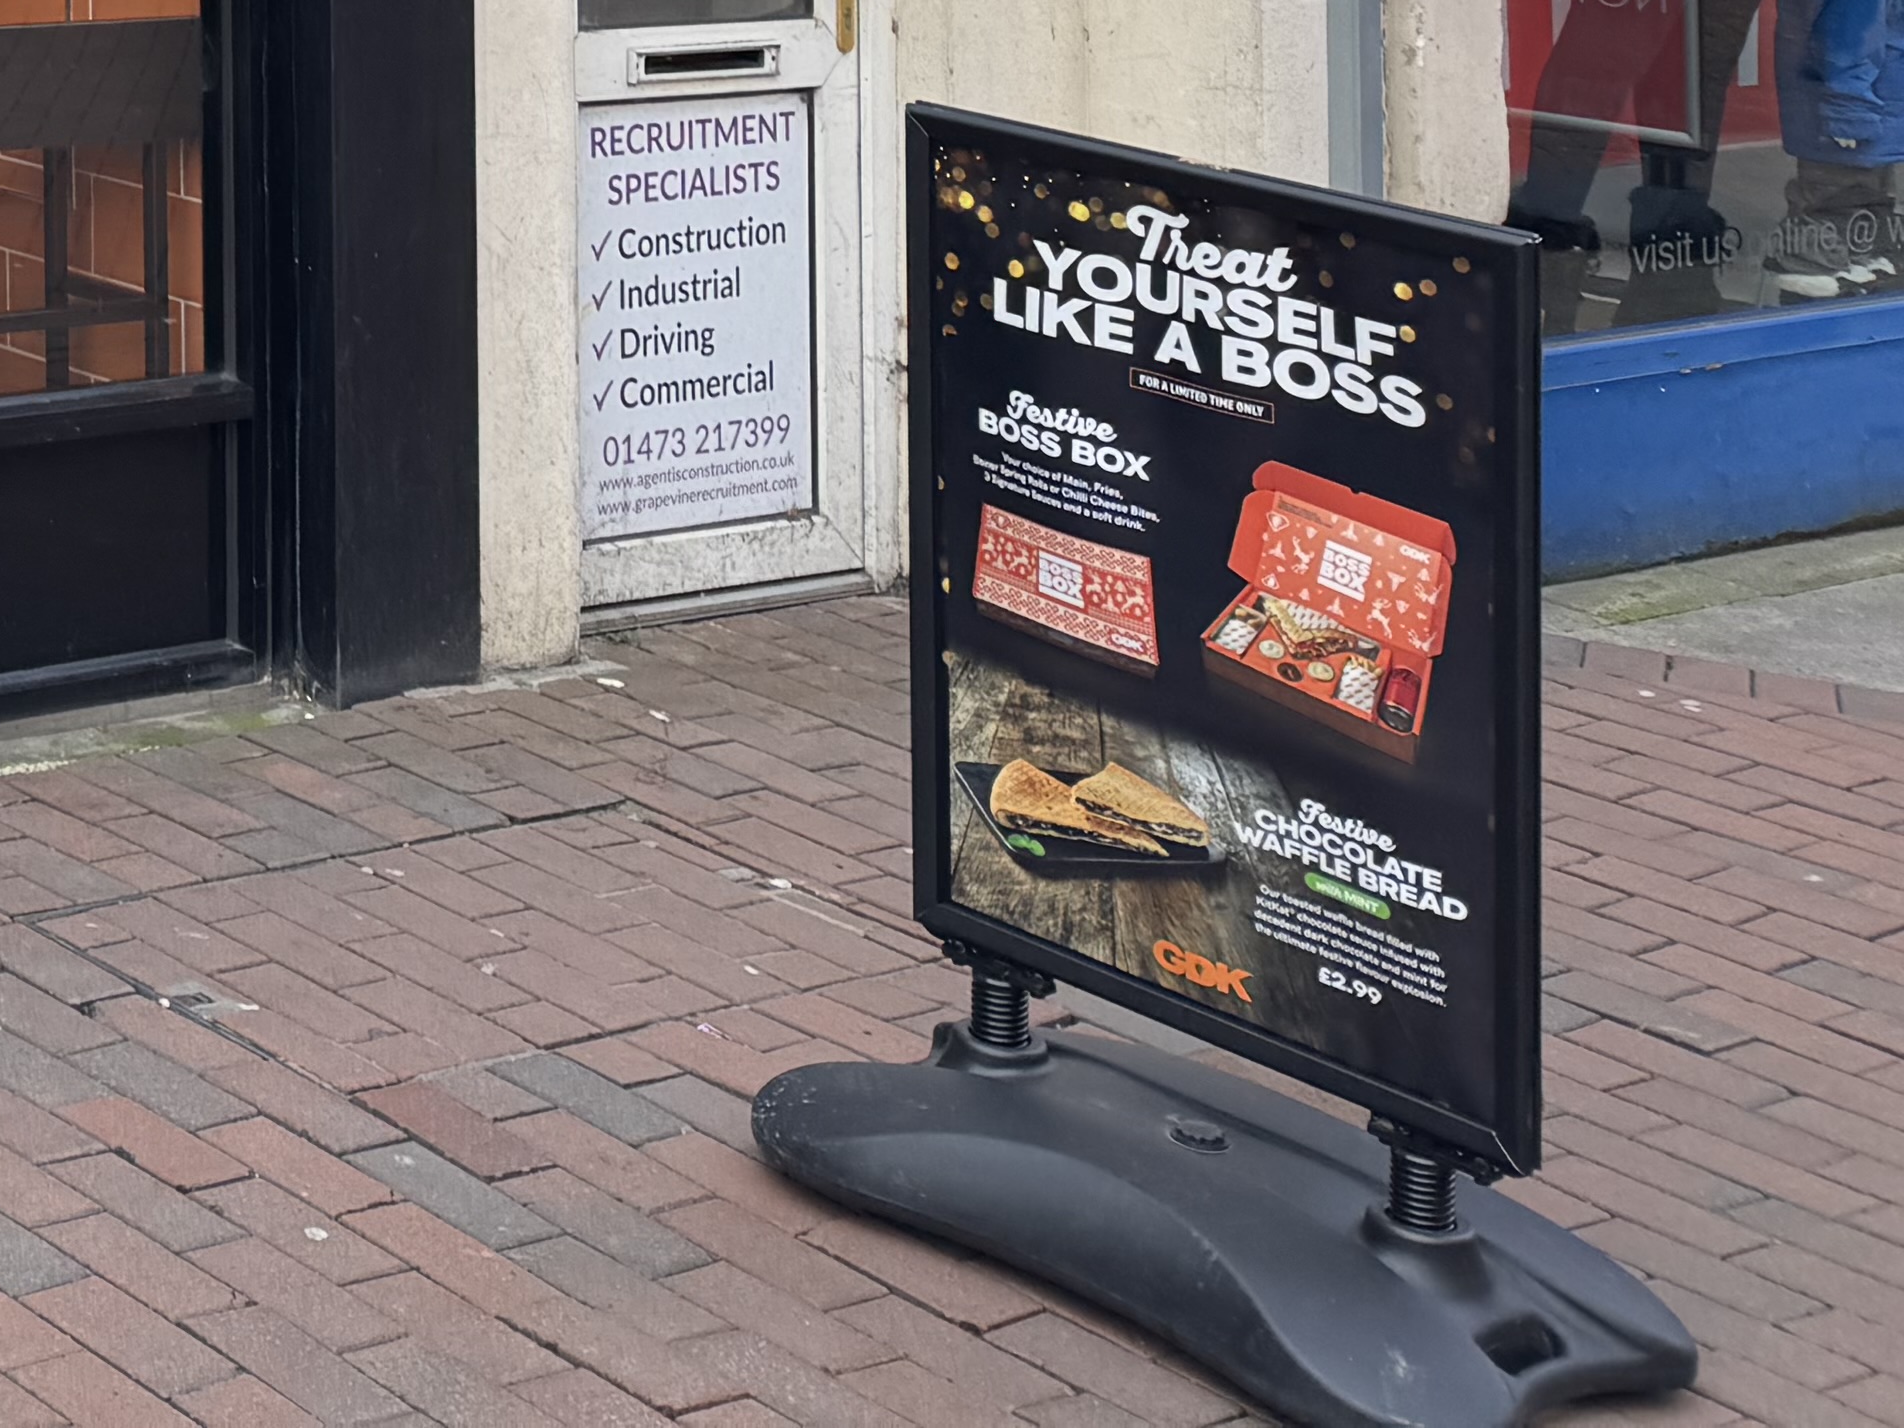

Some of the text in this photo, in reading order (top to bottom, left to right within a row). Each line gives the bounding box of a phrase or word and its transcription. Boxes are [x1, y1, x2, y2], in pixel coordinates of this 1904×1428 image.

[590, 111, 796, 159] RECRUITMENT
[607, 161, 781, 206] SPECIALISTS
[618, 215, 787, 260] Construction
[1126, 204, 1298, 293] Treat
[1632, 231, 1694, 274] visit
[1847, 209, 1878, 254] @
[619, 265, 741, 311] Industrial
[1033, 240, 1398, 366] YOURSELF
[619, 322, 716, 360] Driving
[992, 277, 1427, 428] LIKE A BOSS
[619, 360, 775, 410] Commercial
[1138, 374, 1265, 417] FOR A LIMITED TIME ONLY
[1006, 389, 1118, 443] Festive
[603, 413, 791, 467] 01473 217399
[978, 407, 1152, 482] BOSS BOX
[598, 450, 796, 494] www.agentisconstruction.co.uk
[1062, 472, 1093, 492] Main,
[1093, 481, 1125, 501] Fries,
[596, 475, 799, 517] www.grapevinerecruitment.com
[1061, 482, 1089, 504] Chilli
[1089, 494, 1130, 515] Cheese
[1038, 555, 1084, 586] BOSS
[1038, 568, 1085, 600] BOX
[1319, 561, 1367, 592] BOX
[1323, 544, 1372, 578] BOSS
[1298, 798, 1397, 852] Festive
[1234, 822, 1469, 921] WAFFLE BREAD
[1254, 808, 1442, 892] CHOCOLATE
[1259, 884, 1281, 899] Our
[1355, 918, 1385, 942] bread
[1414, 943, 1441, 962] with
[1341, 890, 1380, 913] MINT
[1254, 922, 1272, 937] the
[1318, 943, 1354, 967] festive
[1296, 911, 1348, 939] chocolate
[1419, 959, 1446, 979] with
[1303, 924, 1329, 945] dark
[1330, 937, 1380, 966] chocolate
[1402, 966, 1430, 986] mint
[1152, 939, 1255, 1003] GDK
[1318, 966, 1383, 1005] £2.99
